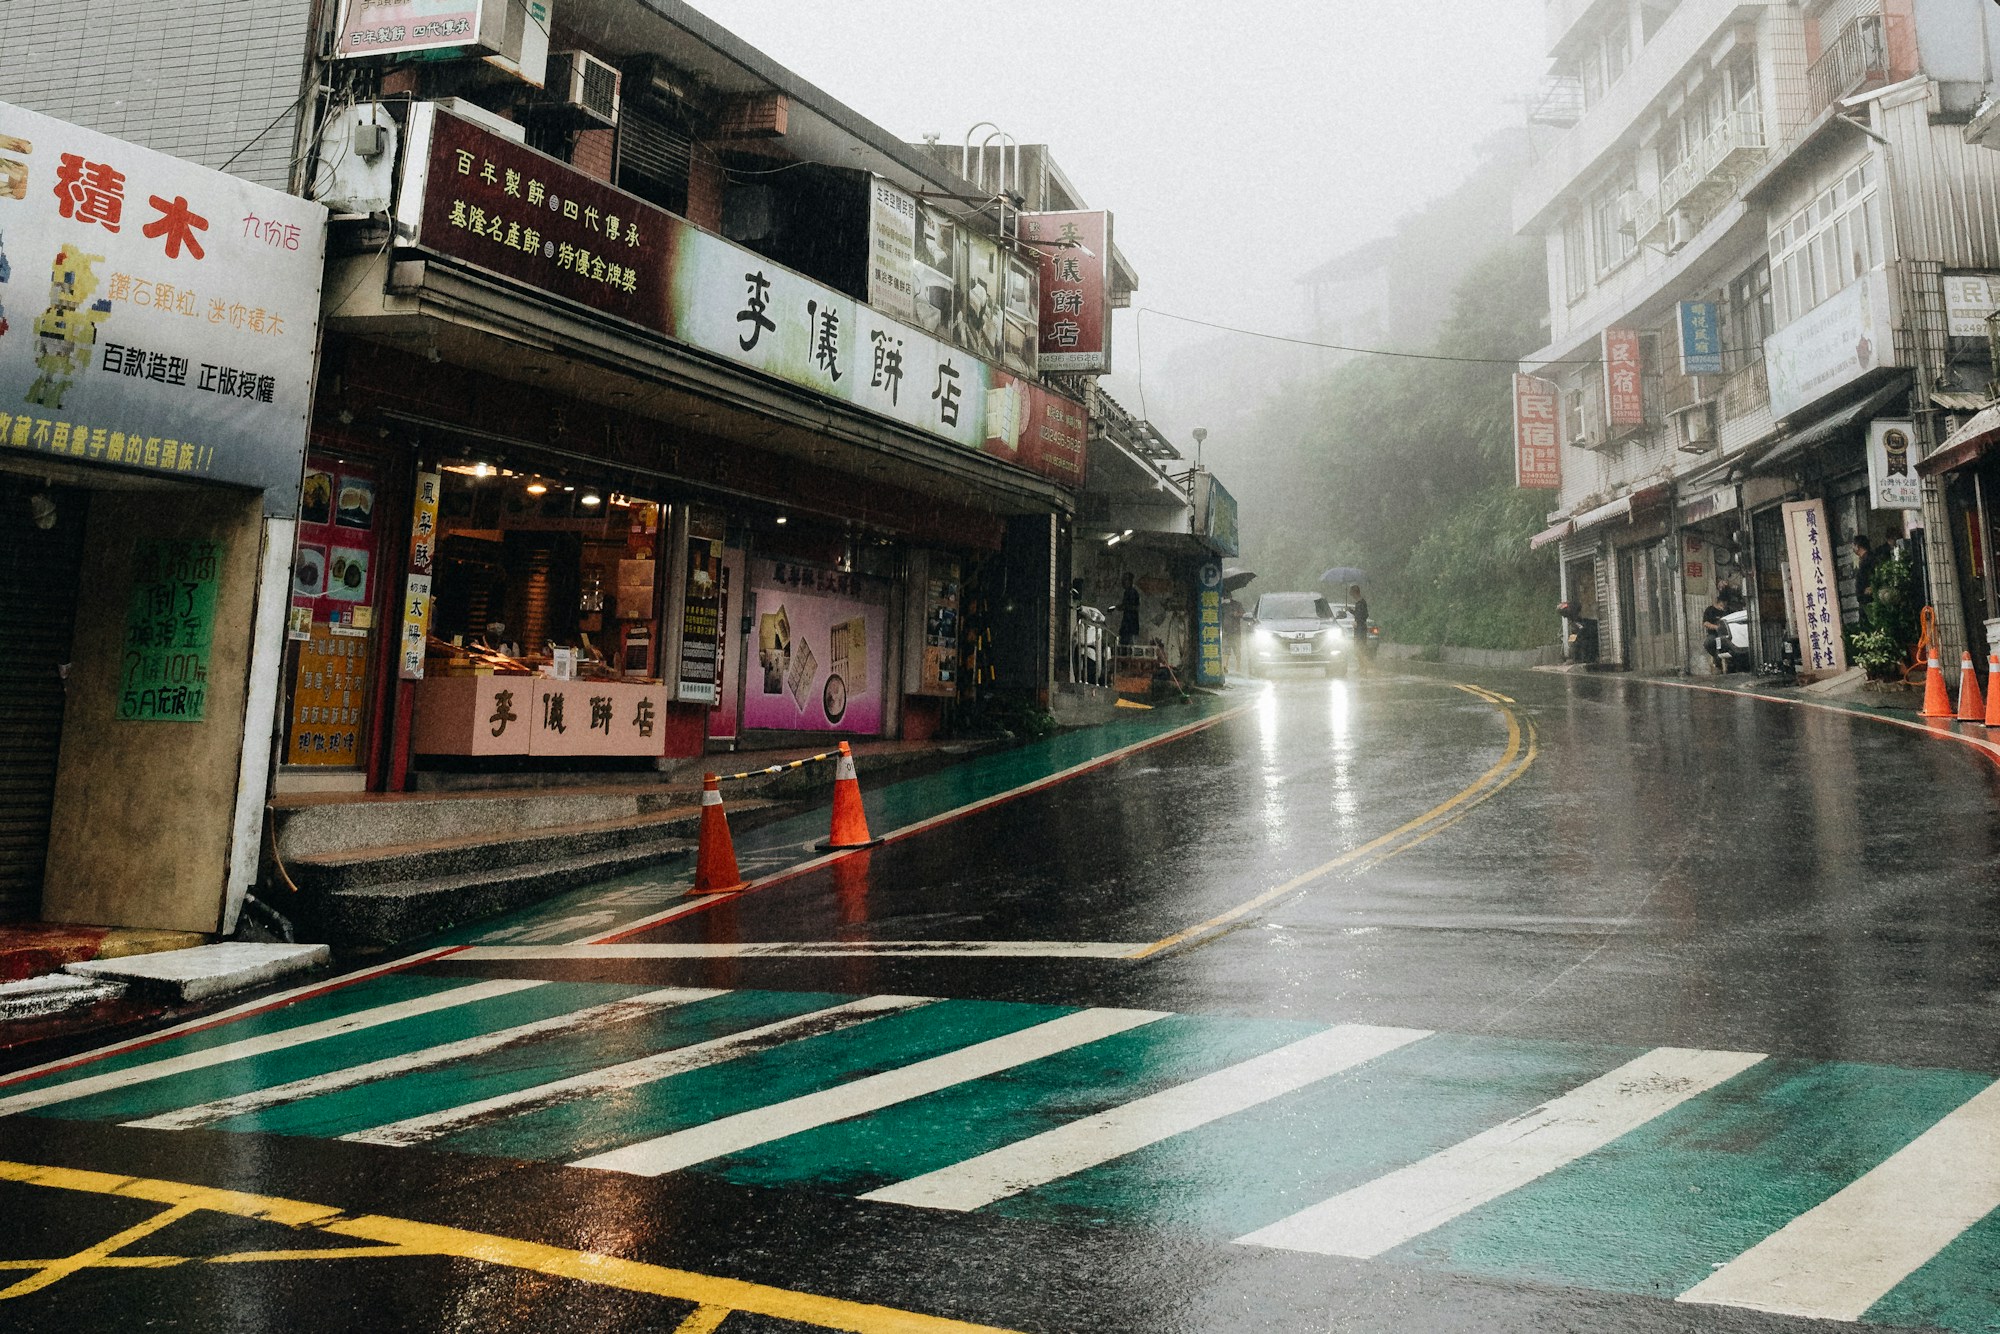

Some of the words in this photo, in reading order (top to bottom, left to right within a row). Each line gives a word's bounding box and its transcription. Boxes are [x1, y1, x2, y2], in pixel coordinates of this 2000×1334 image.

[350, 26, 405, 46] 百年製餅
[413, 18, 470, 38] 四代傳承
[456, 148, 545, 208] 百年製餅
[564, 199, 641, 248] 四代傳承
[243, 212, 301, 250] 九份店
[449, 199, 541, 256] 基隆名產餅
[557, 241, 637, 294] 特優金牌獎
[1049, 222, 1085, 347] 李儀餅店
[207, 298, 285, 336] 迷你積木
[102, 342, 189, 386] 百款造型
[197, 363, 275, 403] 正版授權
[736, 270, 961, 428] 李儀餅店
[1612, 343, 1636, 393] 民宿
[1521, 395, 1555, 446] 民宿
[414, 482, 434, 567] 鳳梨酥
[410, 583, 429, 594] 奶油
[1805, 508, 1835, 666] 顯考林公阿南先生
[405, 597, 423, 673] 太陽餅
[489, 690, 655, 738] 李儀餅店
